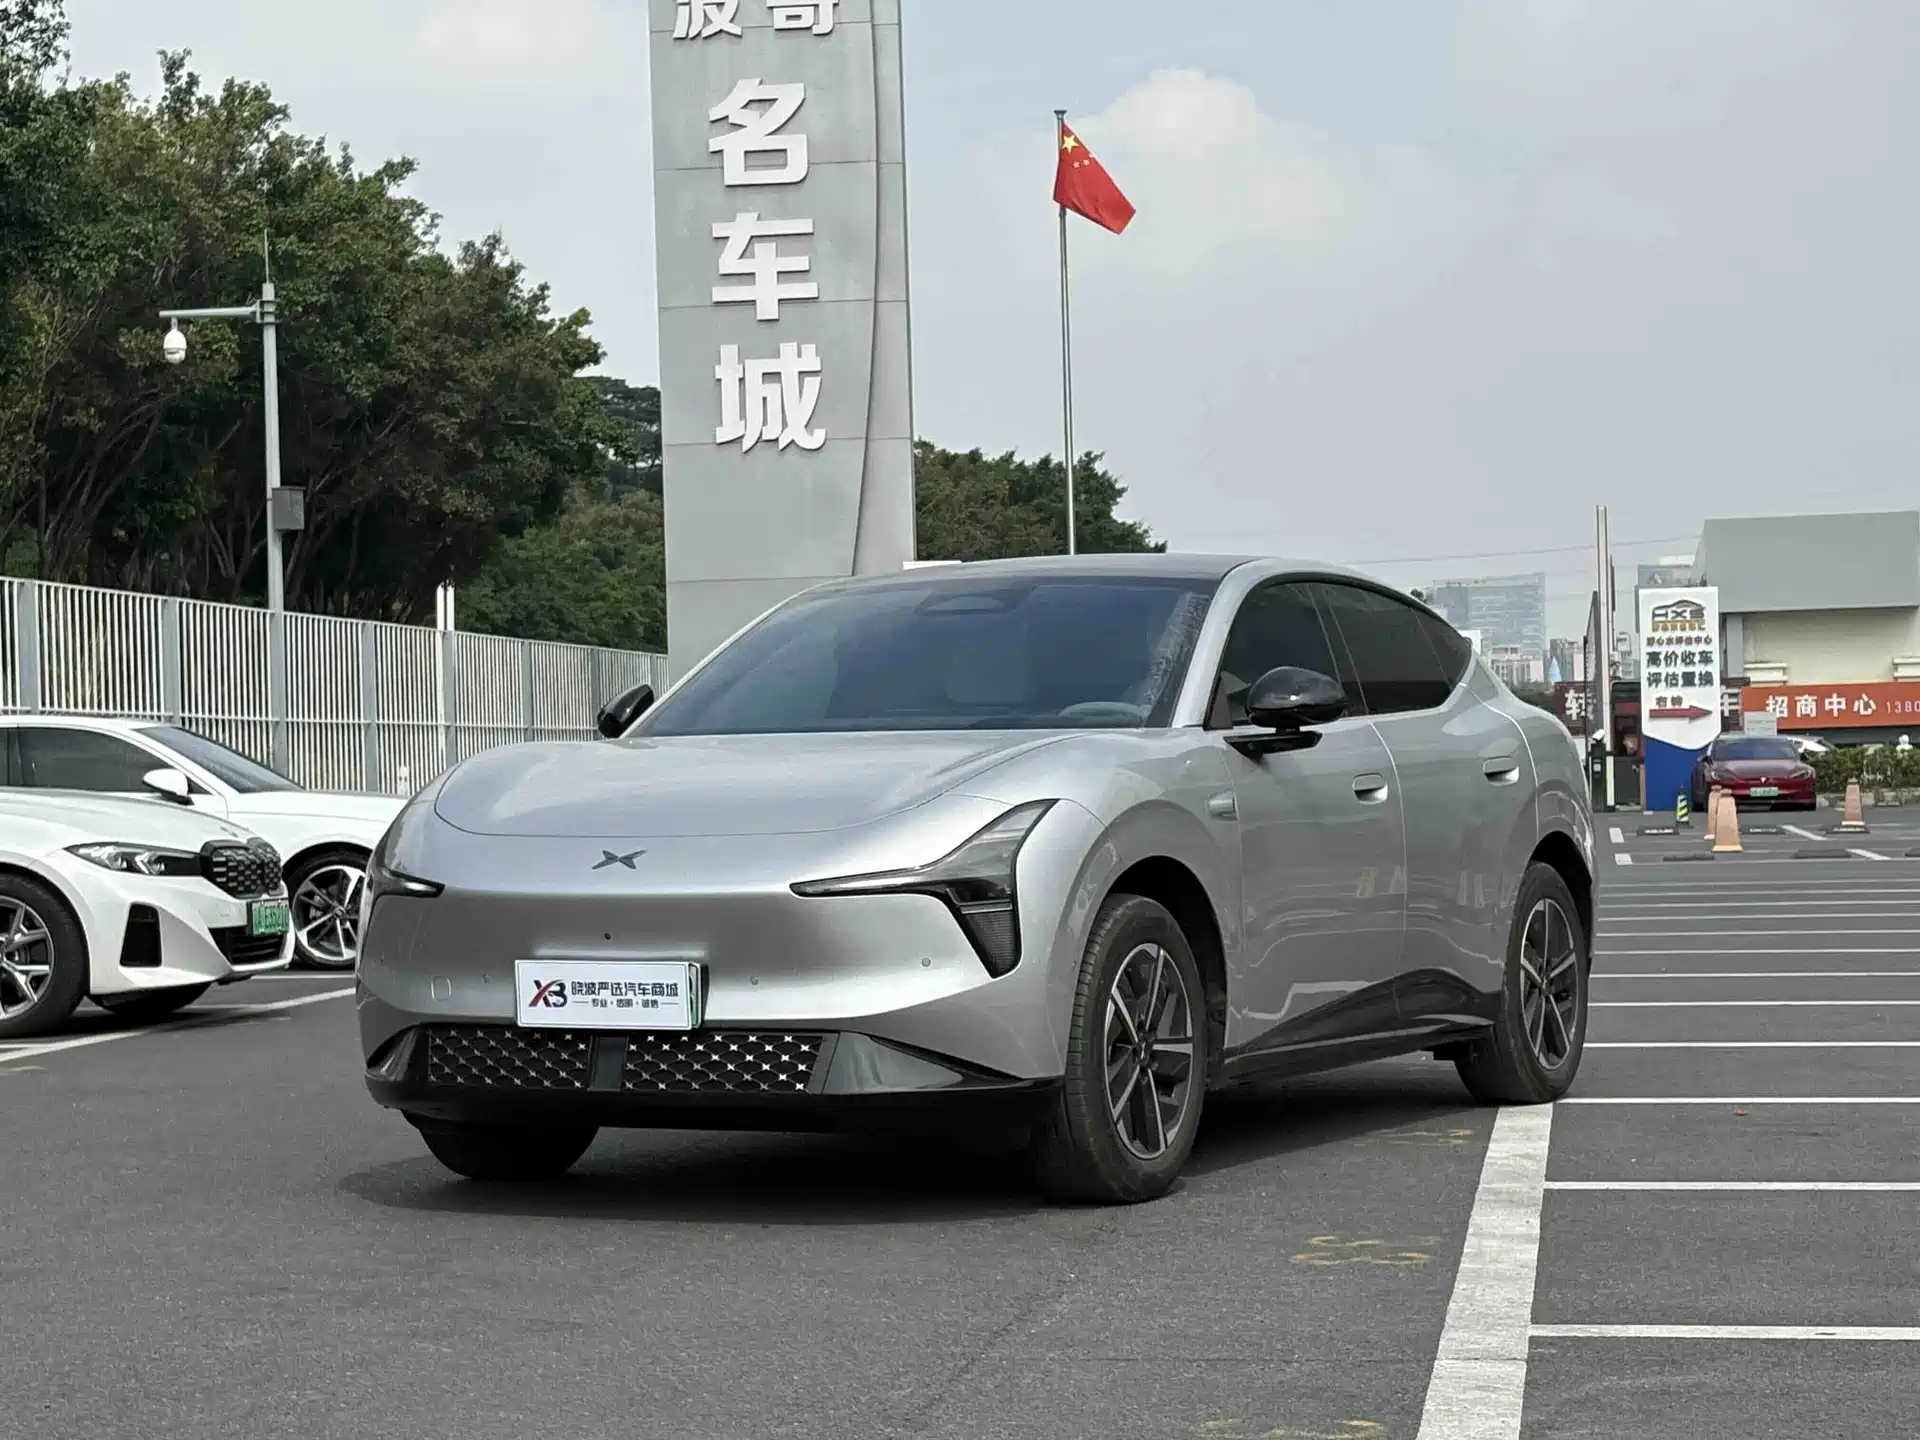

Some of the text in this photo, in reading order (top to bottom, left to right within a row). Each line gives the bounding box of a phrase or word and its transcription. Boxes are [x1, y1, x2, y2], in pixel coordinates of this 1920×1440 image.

[708, 78, 827, 453] 名车城
[1646, 651, 1714, 668] 高价收车
[1647, 671, 1714, 688] 评估置换
[1765, 692, 1877, 719] 招商中心
[571, 981, 679, 997] 晓波严选汽车商城
